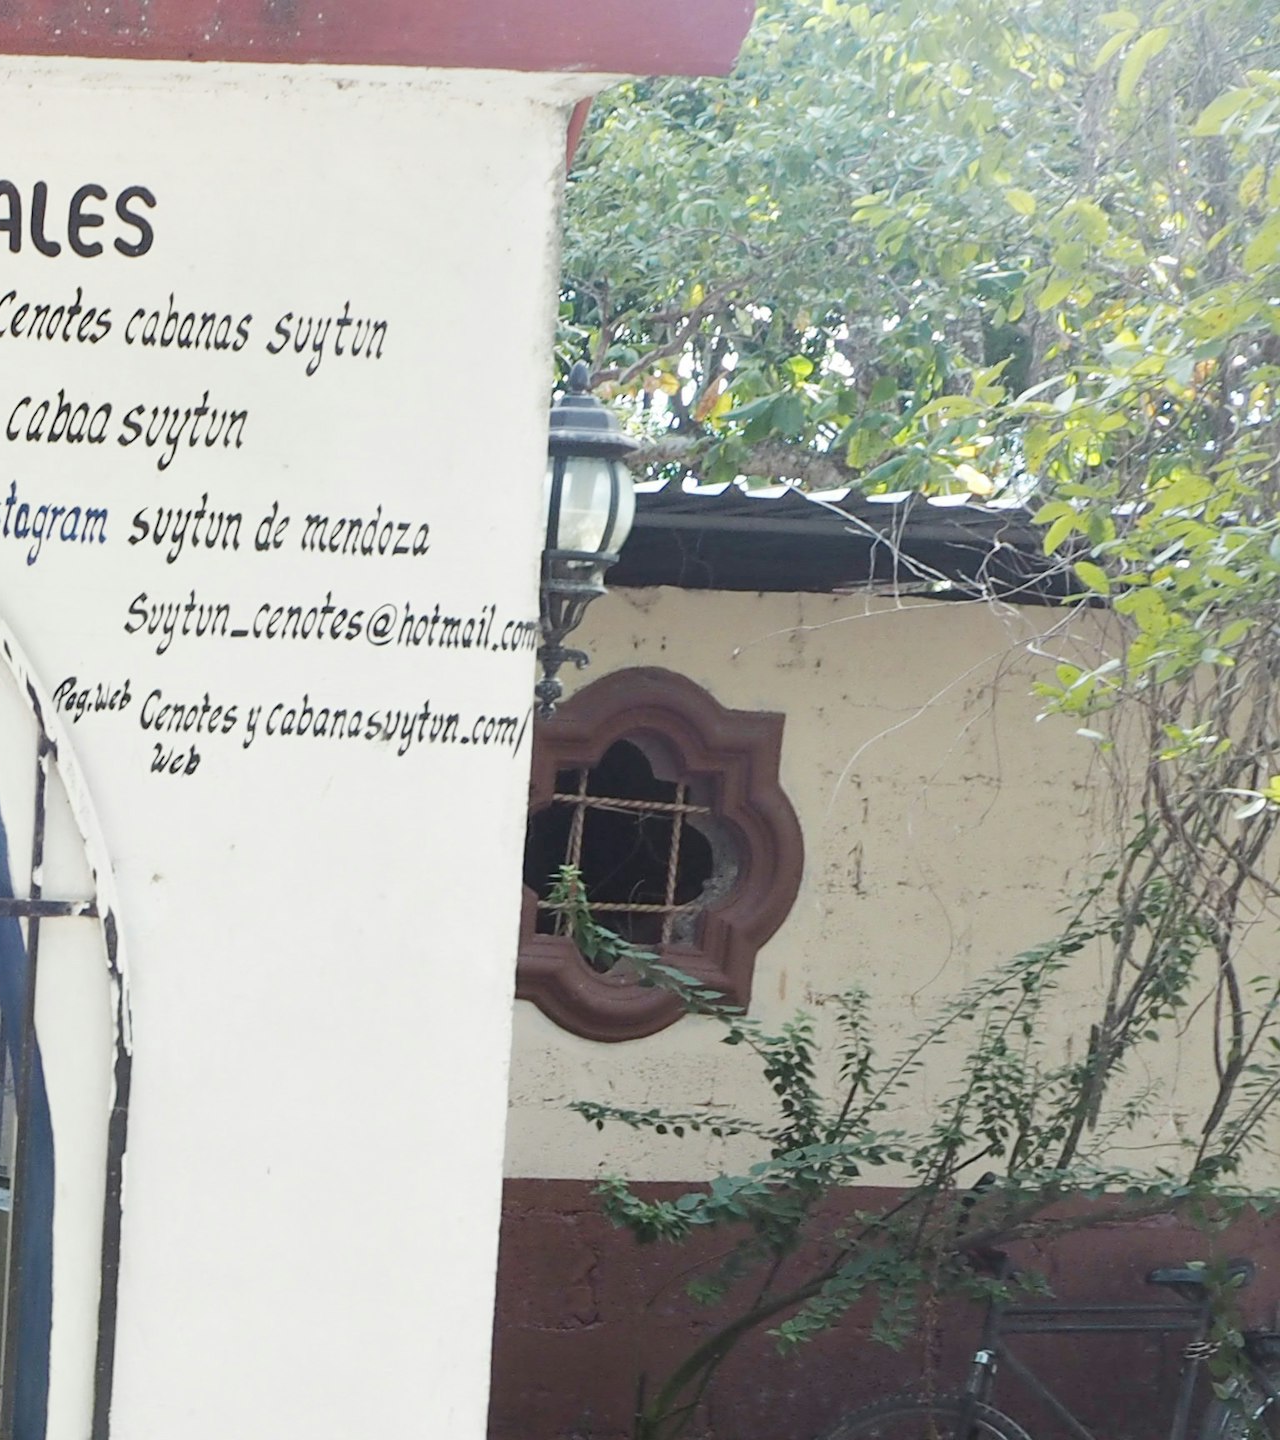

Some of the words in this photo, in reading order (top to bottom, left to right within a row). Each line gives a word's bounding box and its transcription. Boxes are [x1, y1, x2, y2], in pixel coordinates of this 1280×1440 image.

[124, 292, 253, 352] cabanas
[254, 500, 290, 552] de
[301, 505, 430, 557] mendoza
[139, 689, 238, 734] Cenotes
[242, 705, 262, 750] y
[150, 742, 201, 777] Web
